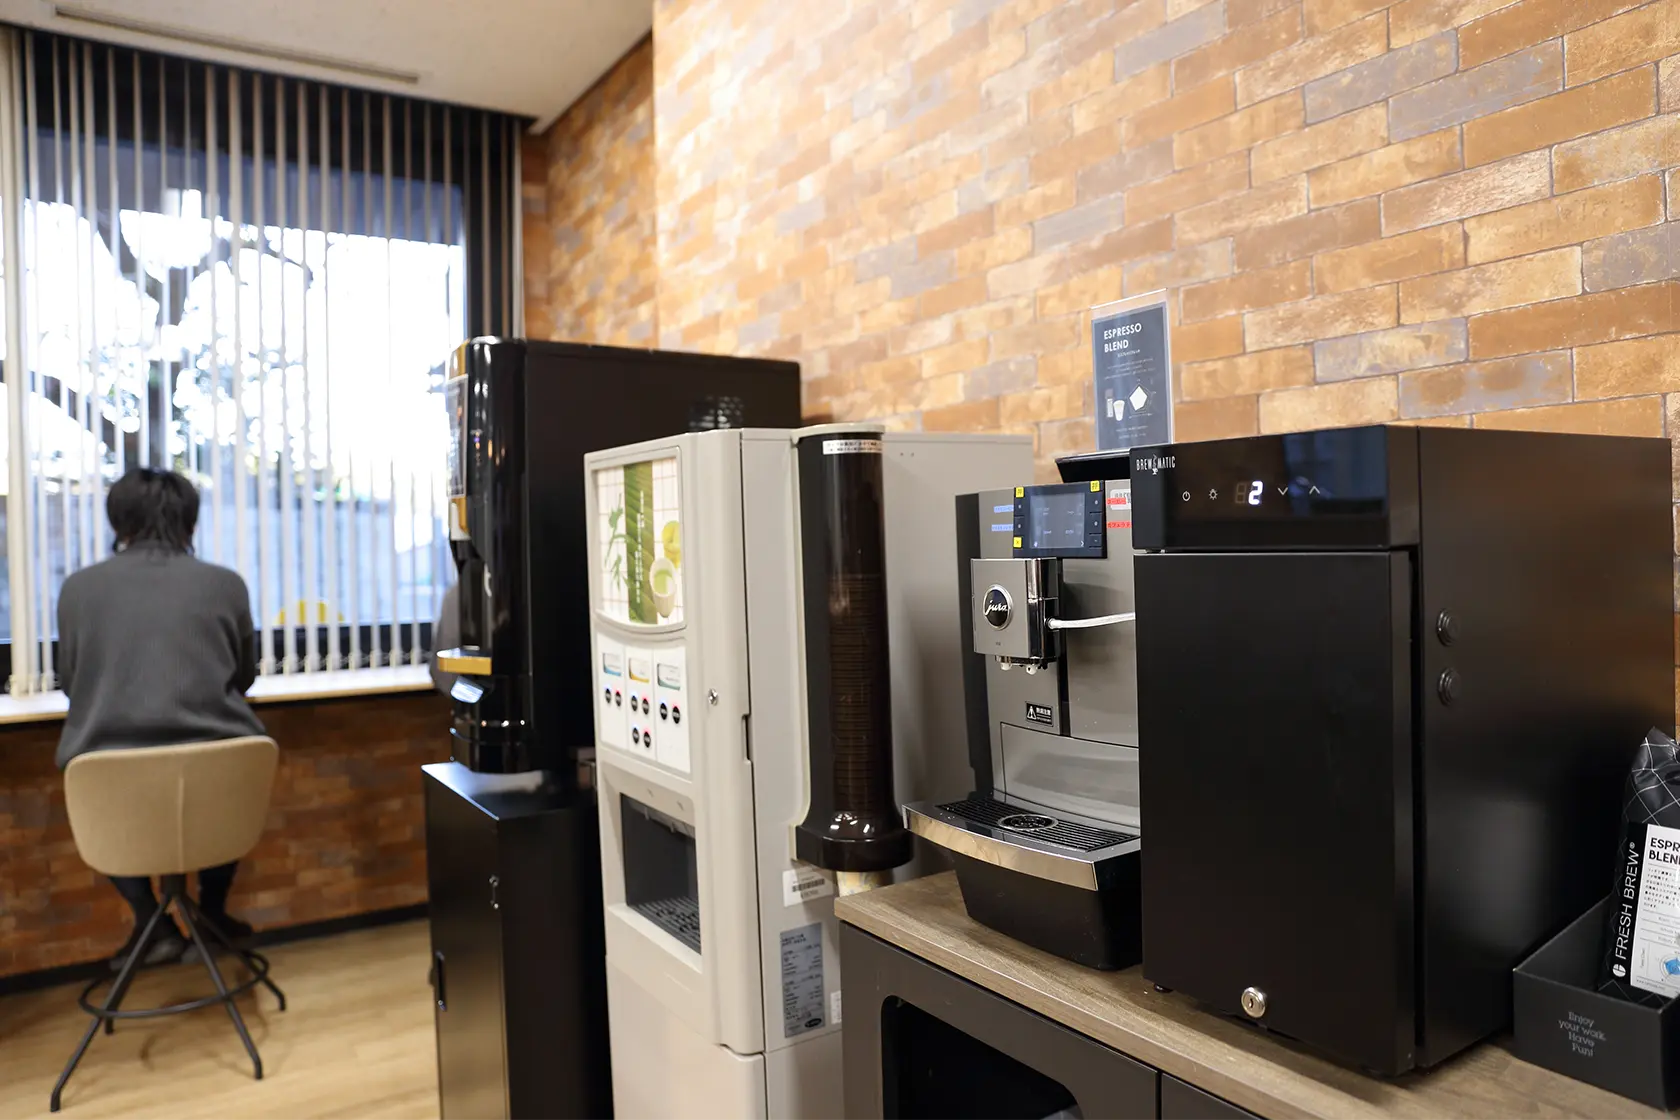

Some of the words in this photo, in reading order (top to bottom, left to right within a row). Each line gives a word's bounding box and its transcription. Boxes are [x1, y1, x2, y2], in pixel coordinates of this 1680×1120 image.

[1103, 322, 1142, 340] ESPRESSO
[1103, 339, 1129, 353] BLEND
[985, 600, 1008, 616] jura
[1648, 849, 1680, 865] BLEN
[1615, 903, 1633, 960] FRESH
[1558, 1020, 1580, 1033] your
[1568, 1011, 1595, 1028] Enjoy
[1568, 1031, 1595, 1048] Have
